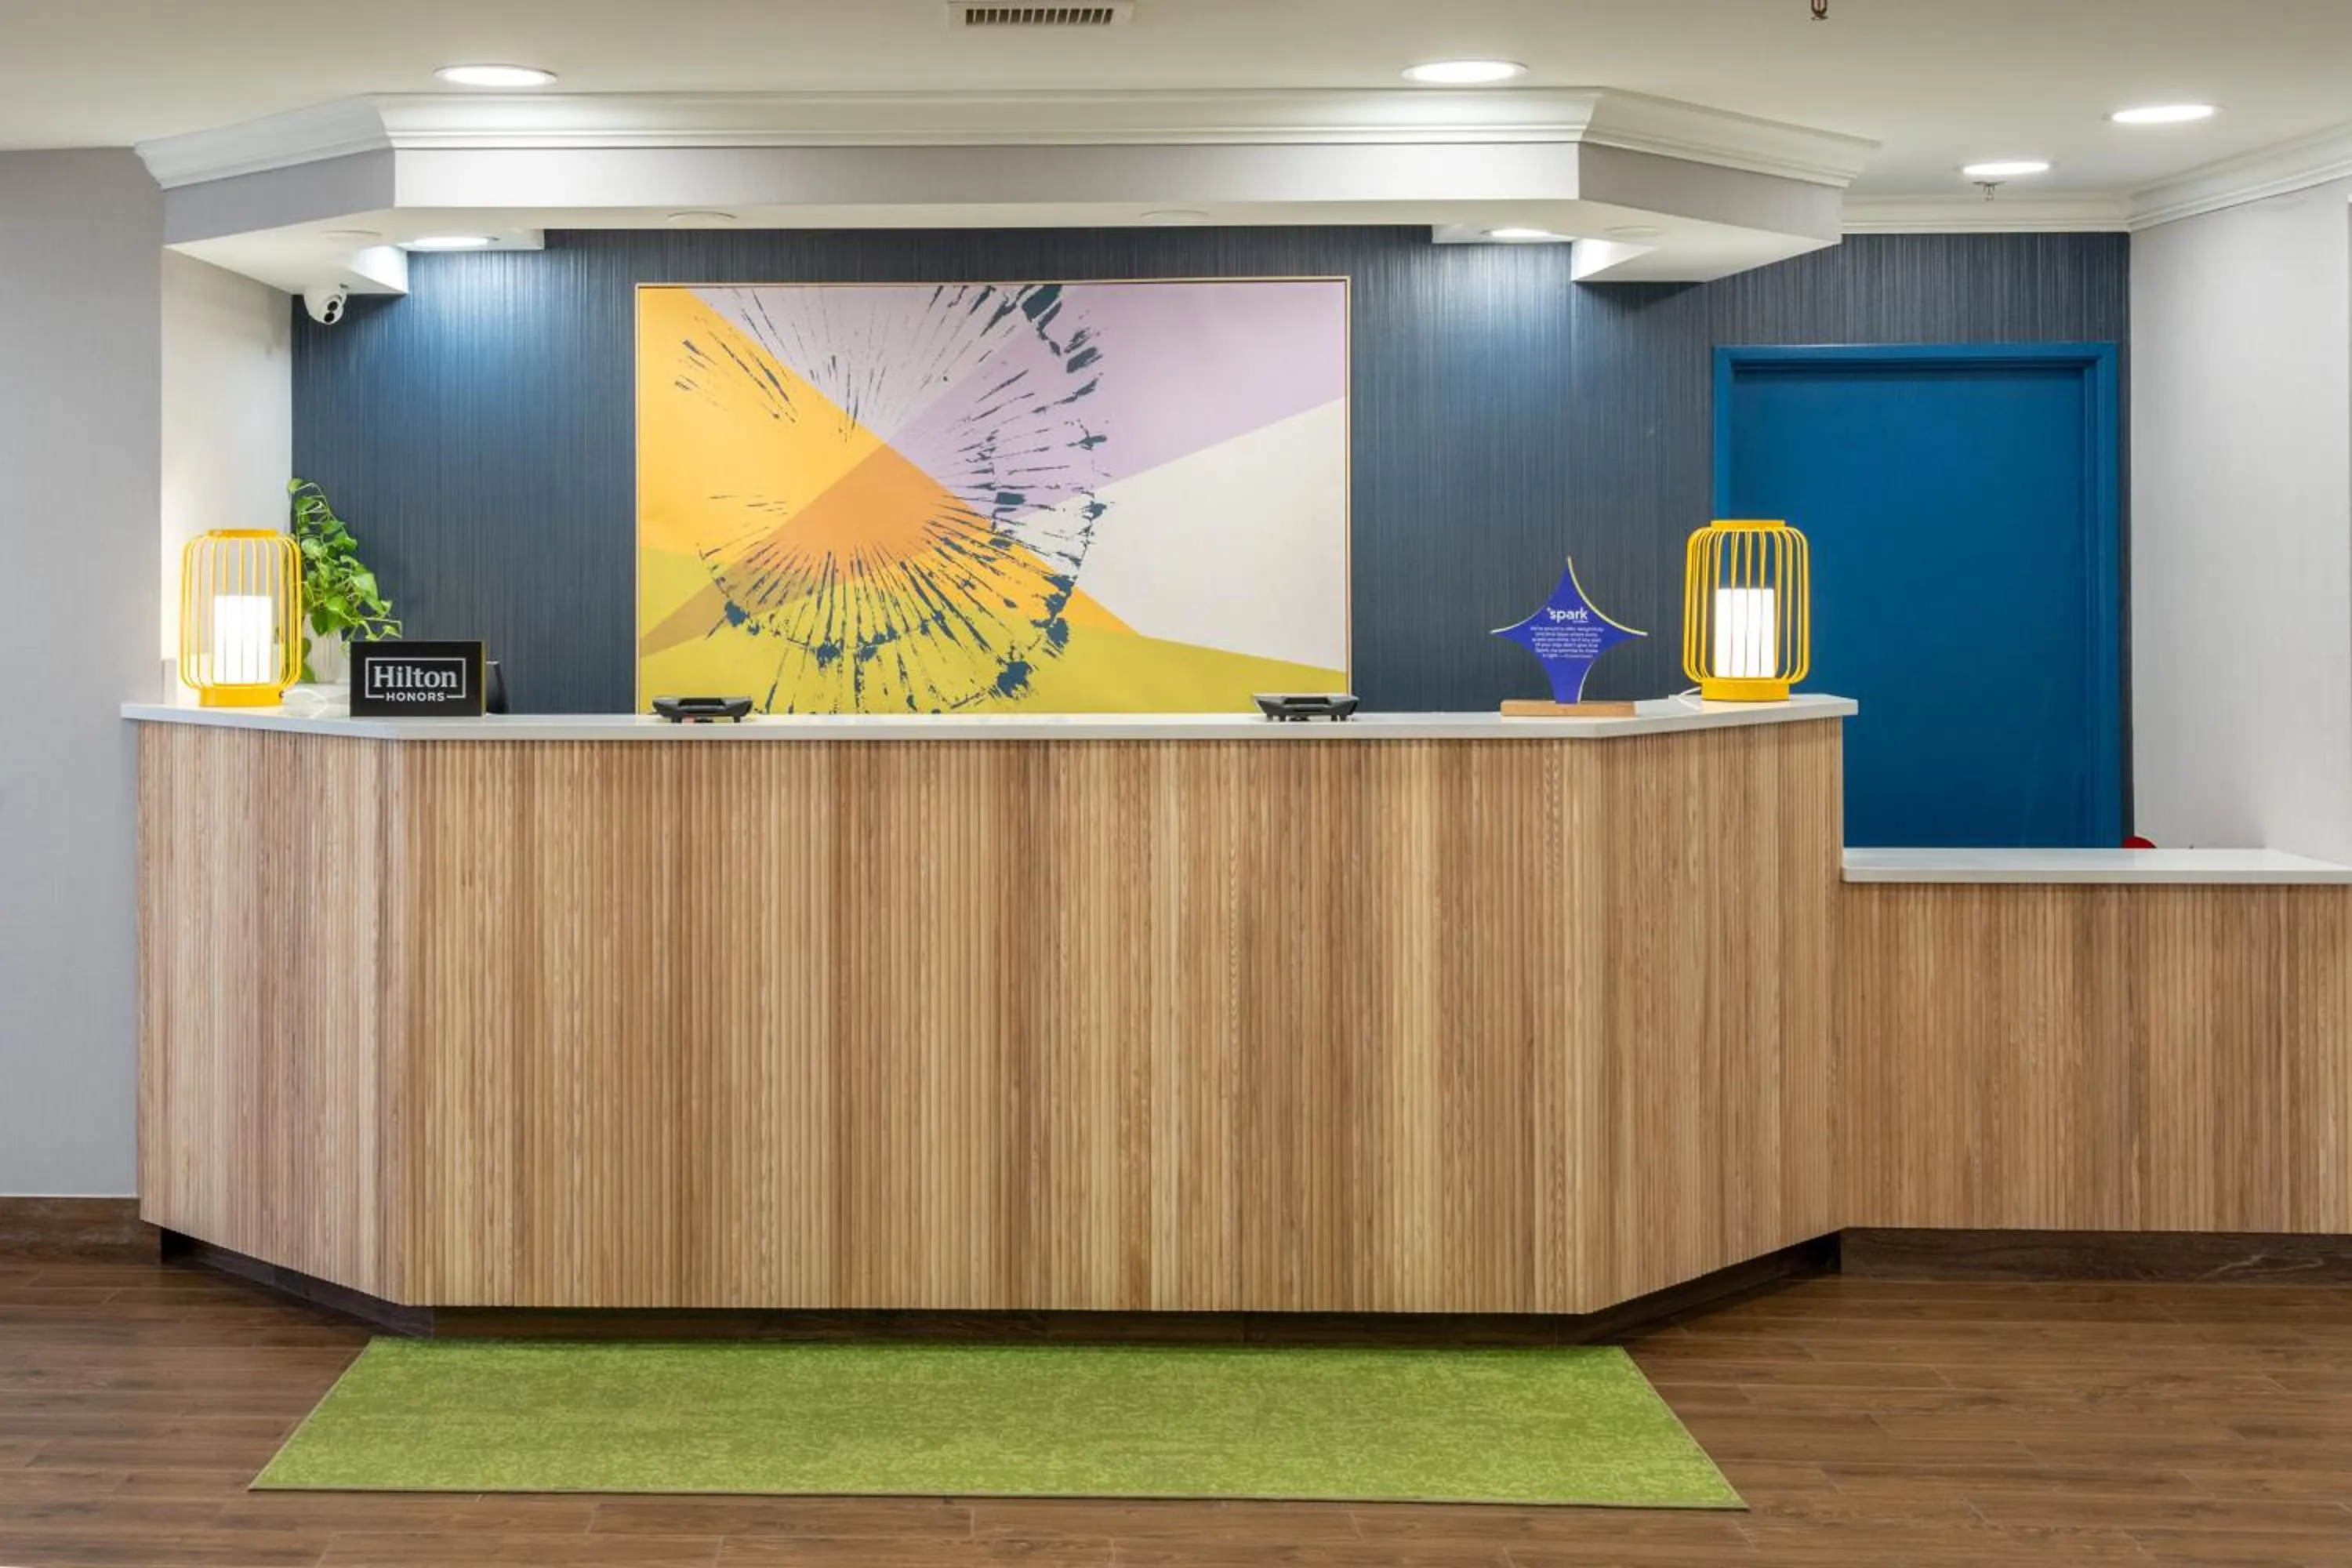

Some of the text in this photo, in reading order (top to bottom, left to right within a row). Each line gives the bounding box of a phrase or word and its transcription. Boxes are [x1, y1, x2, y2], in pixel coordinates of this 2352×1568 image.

[1550, 607, 1588, 623] spark
[373, 665, 458, 688] Hilton
[386, 692, 445, 702] HONORS
